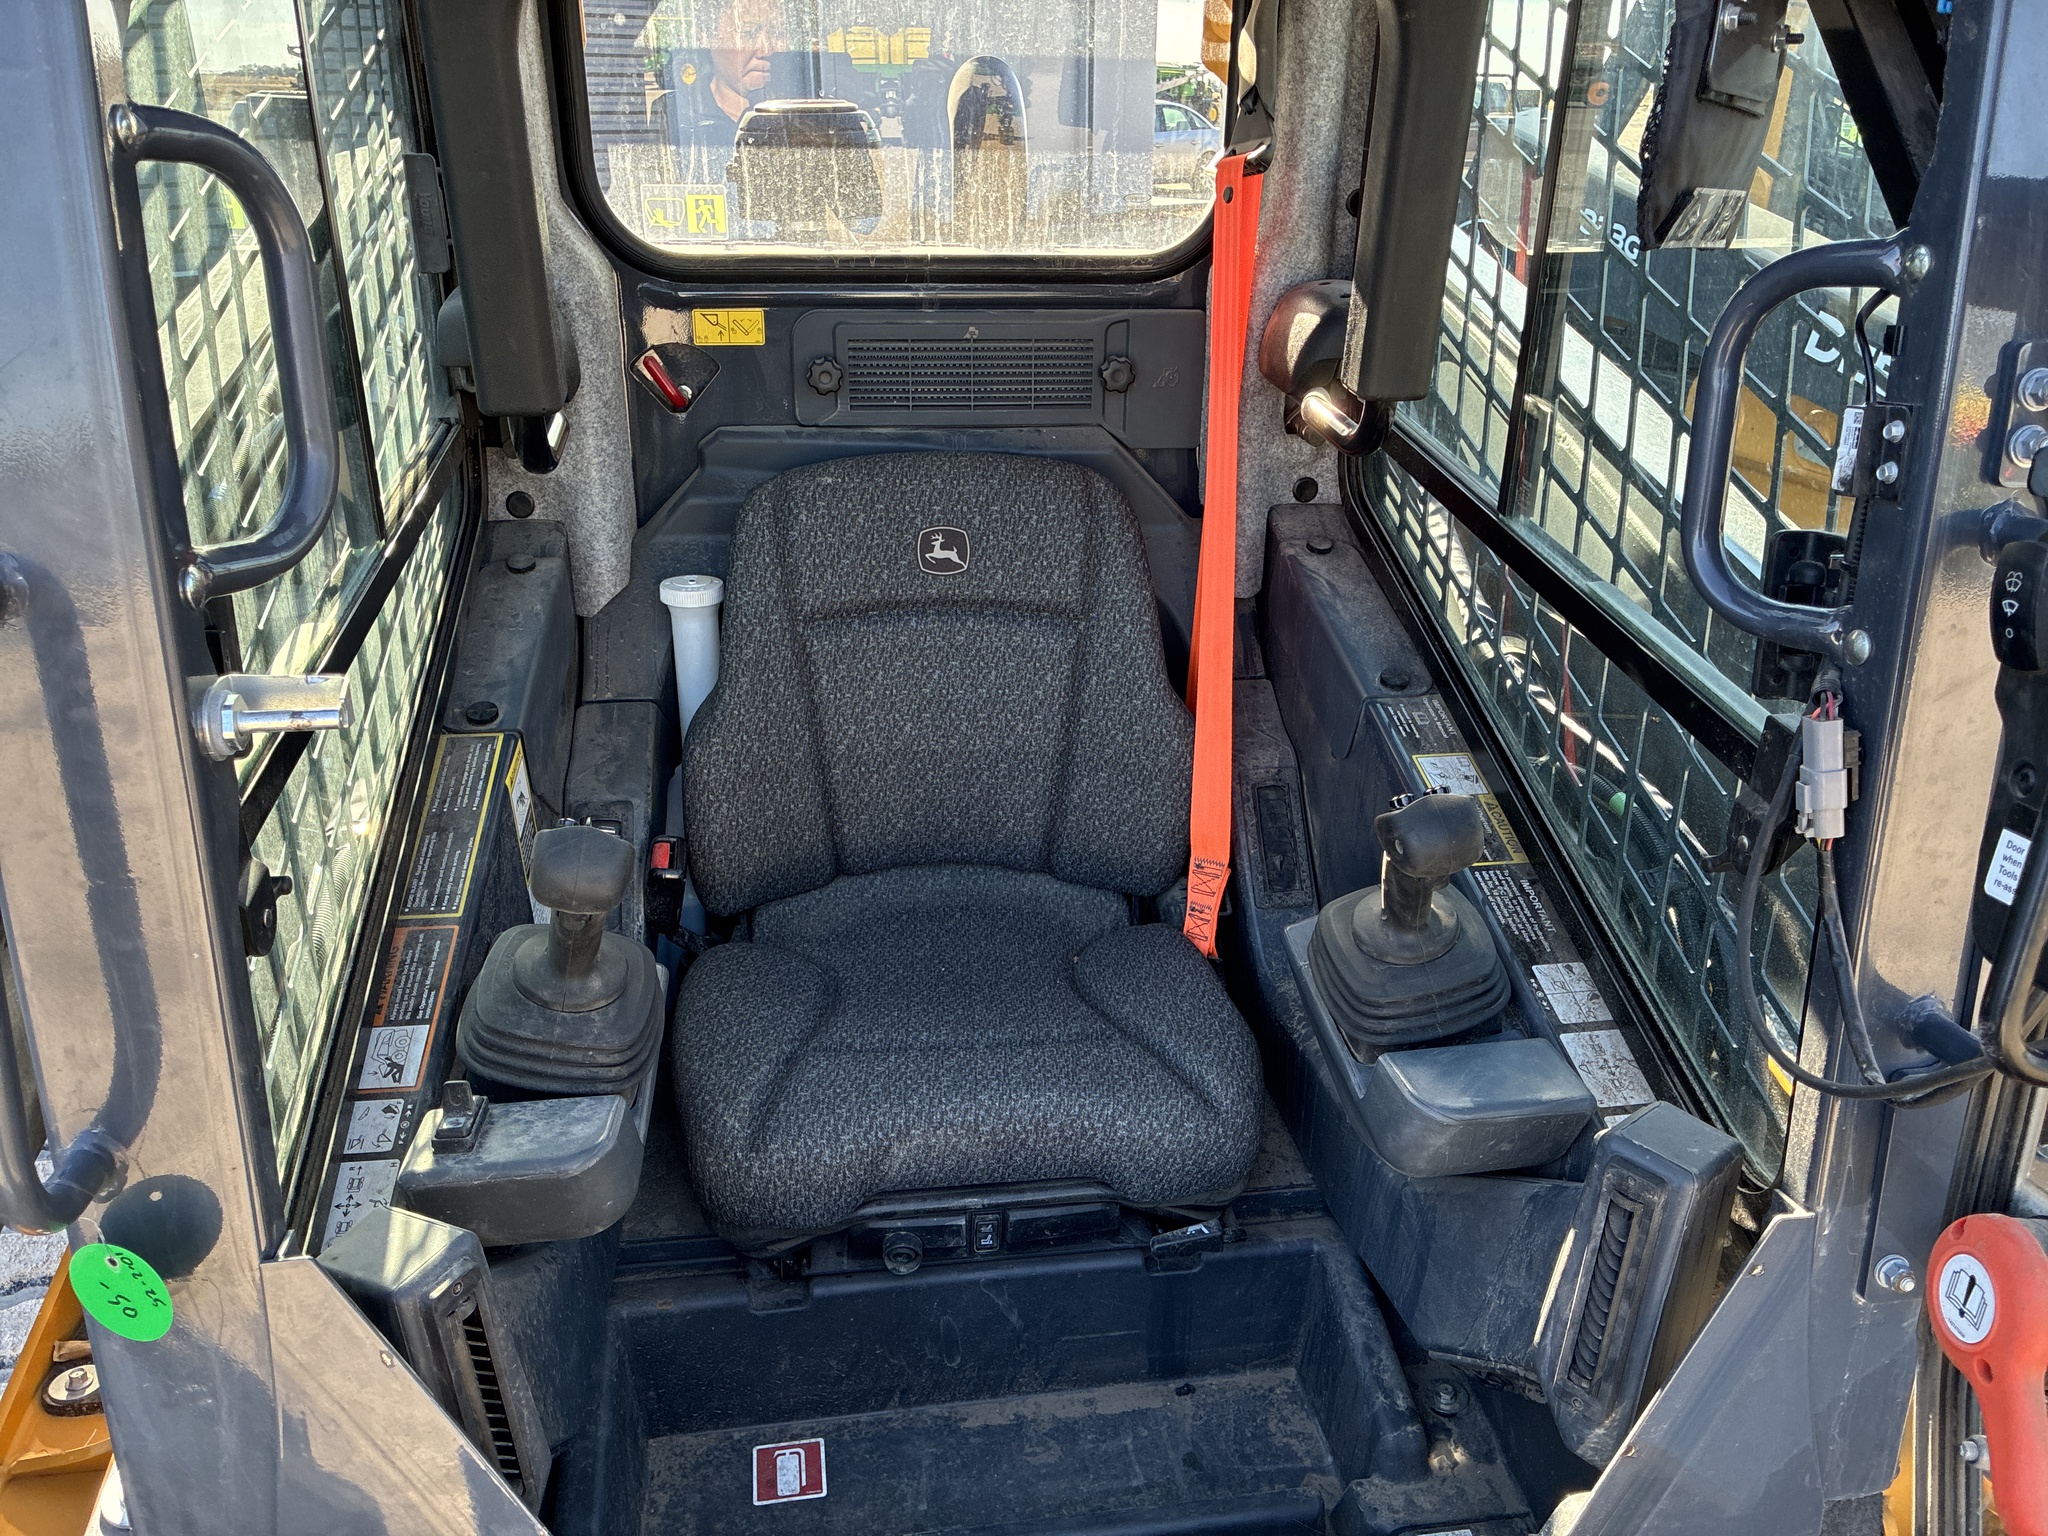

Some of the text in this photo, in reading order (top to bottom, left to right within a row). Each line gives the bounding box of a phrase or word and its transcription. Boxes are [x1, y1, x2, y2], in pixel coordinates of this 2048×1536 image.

[1432, 700, 1456, 734] IMPORTANT
[1491, 811, 1523, 854] CAUTION
[2006, 840, 2025, 855] Door
[2003, 854, 2022, 868] when
[1999, 865, 2018, 881] Tools
[1518, 897, 1531, 916] damage
[1521, 880, 1555, 931] IMPORTANT
[419, 986, 429, 1009] Operator's
[390, 1004, 399, 1020] Always
[399, 1001, 407, 1019] working
